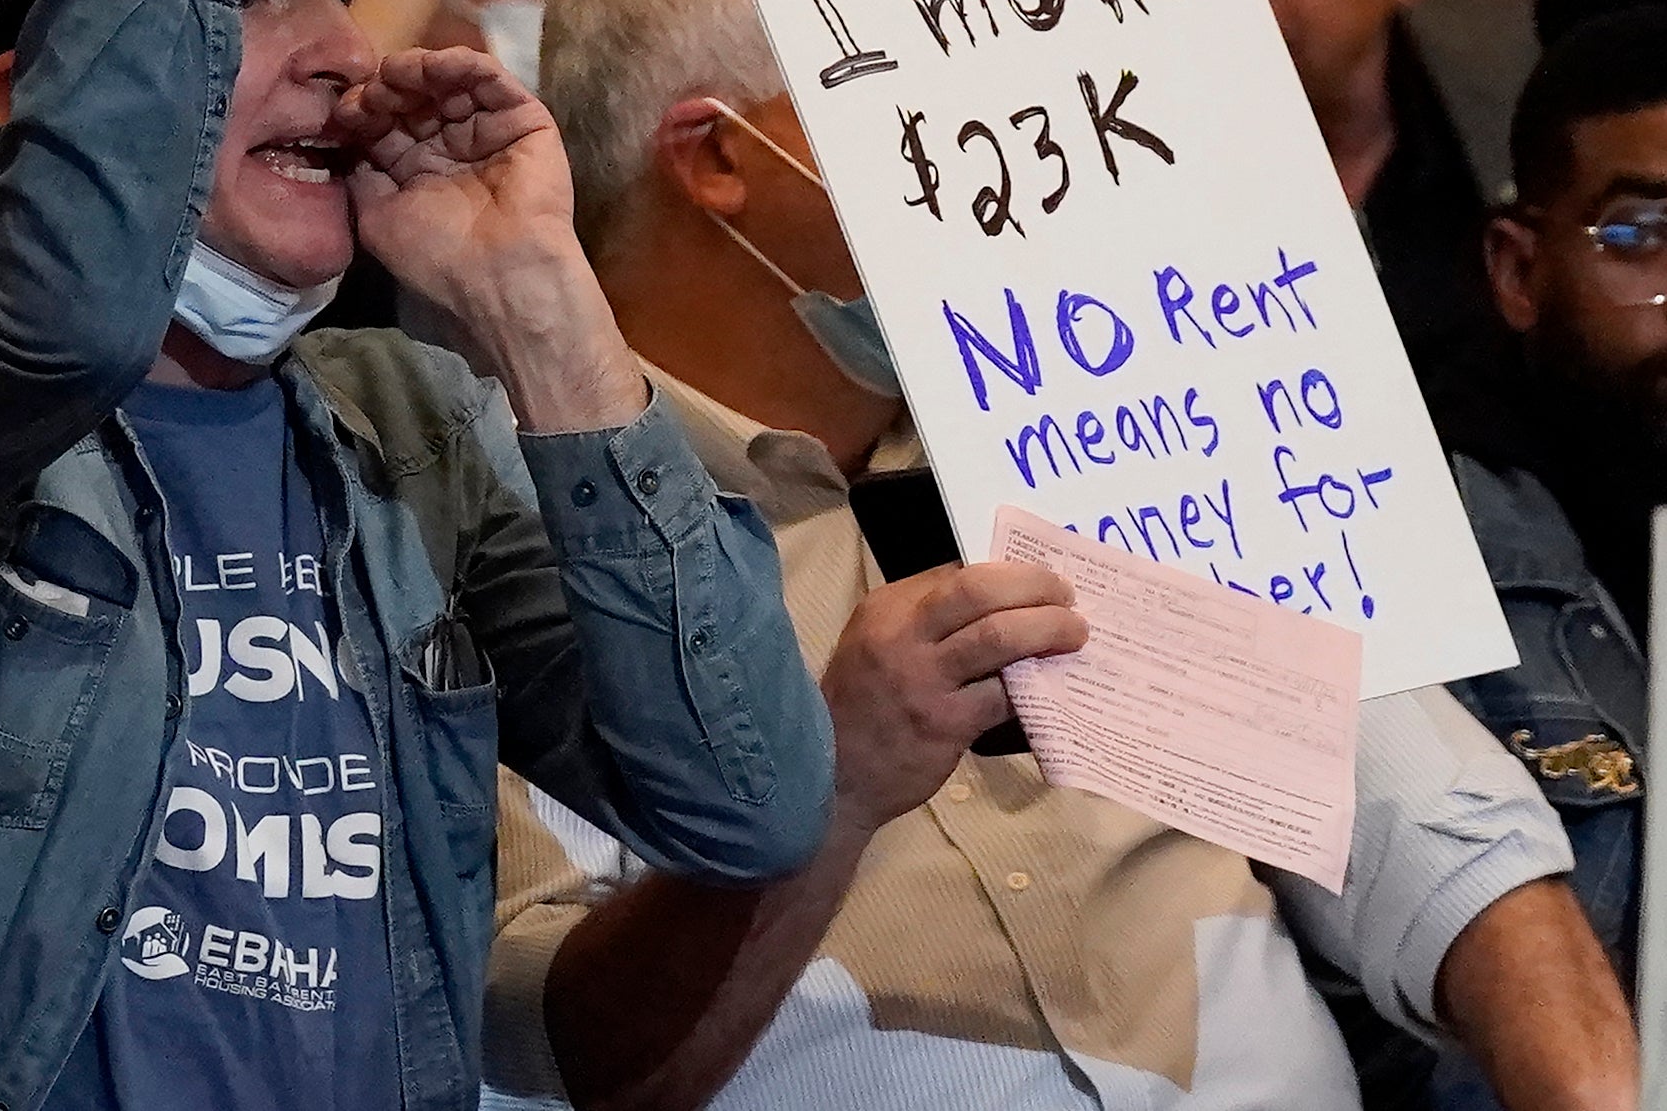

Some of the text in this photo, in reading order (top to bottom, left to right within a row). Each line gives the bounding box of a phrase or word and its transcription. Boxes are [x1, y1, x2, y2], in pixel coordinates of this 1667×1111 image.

[940, 246, 1321, 414] NO Rent
[1004, 367, 1344, 490] means no
[1273, 444, 1394, 534] for
[193, 974, 269, 1000] HOUSING
